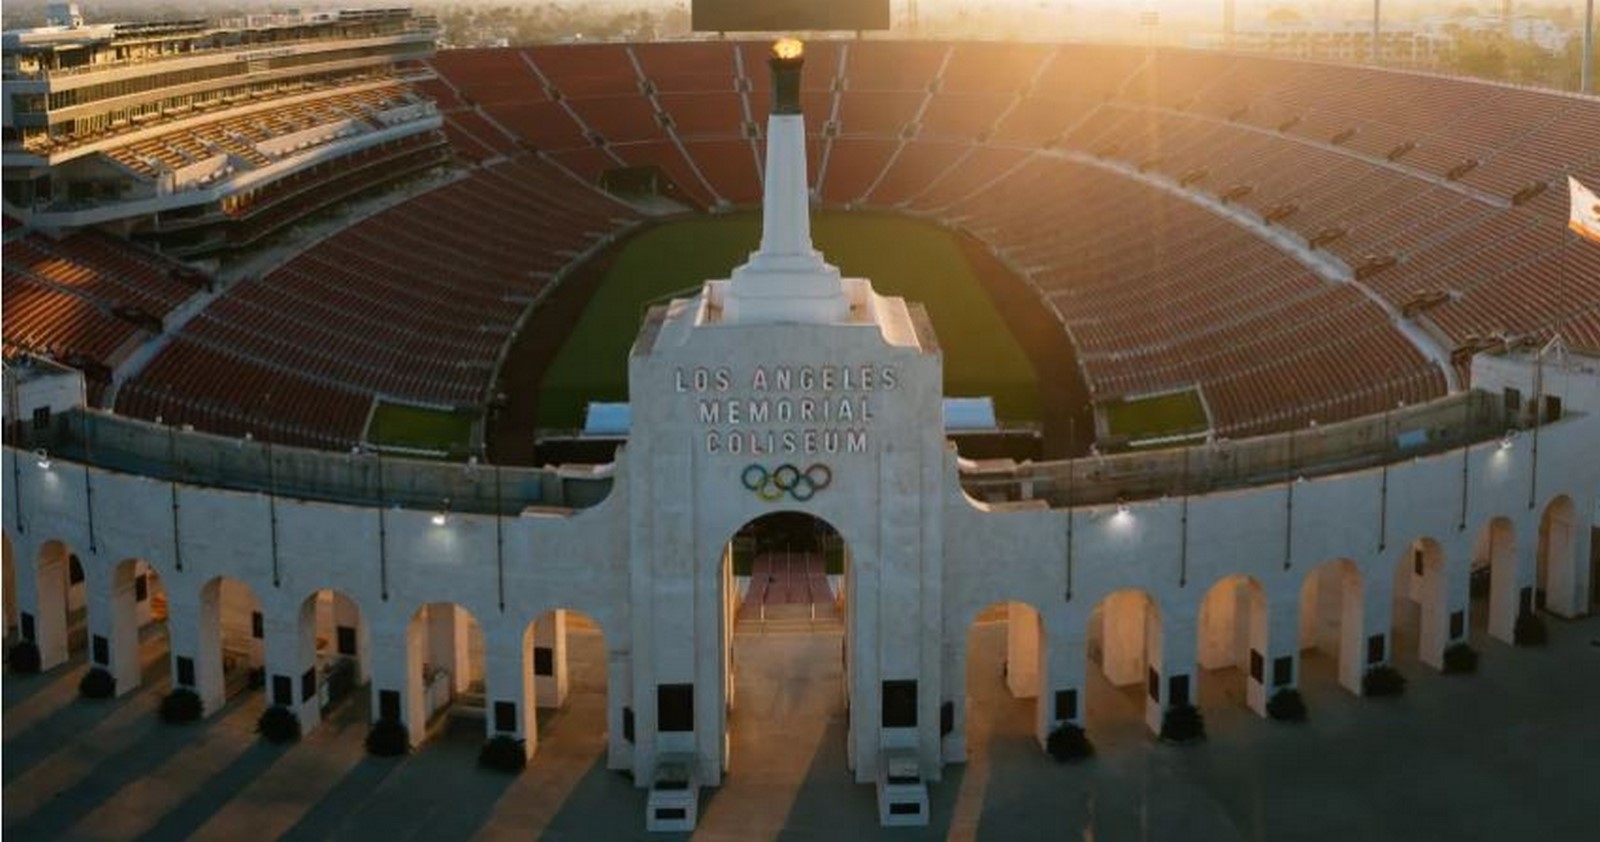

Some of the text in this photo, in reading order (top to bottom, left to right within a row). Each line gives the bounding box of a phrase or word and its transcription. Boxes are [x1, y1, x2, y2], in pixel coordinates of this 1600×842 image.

[676, 366, 896, 392] LOS ANGELES
[700, 400, 873, 424] MEMORIAL
[707, 431, 867, 454] COLISEUM
